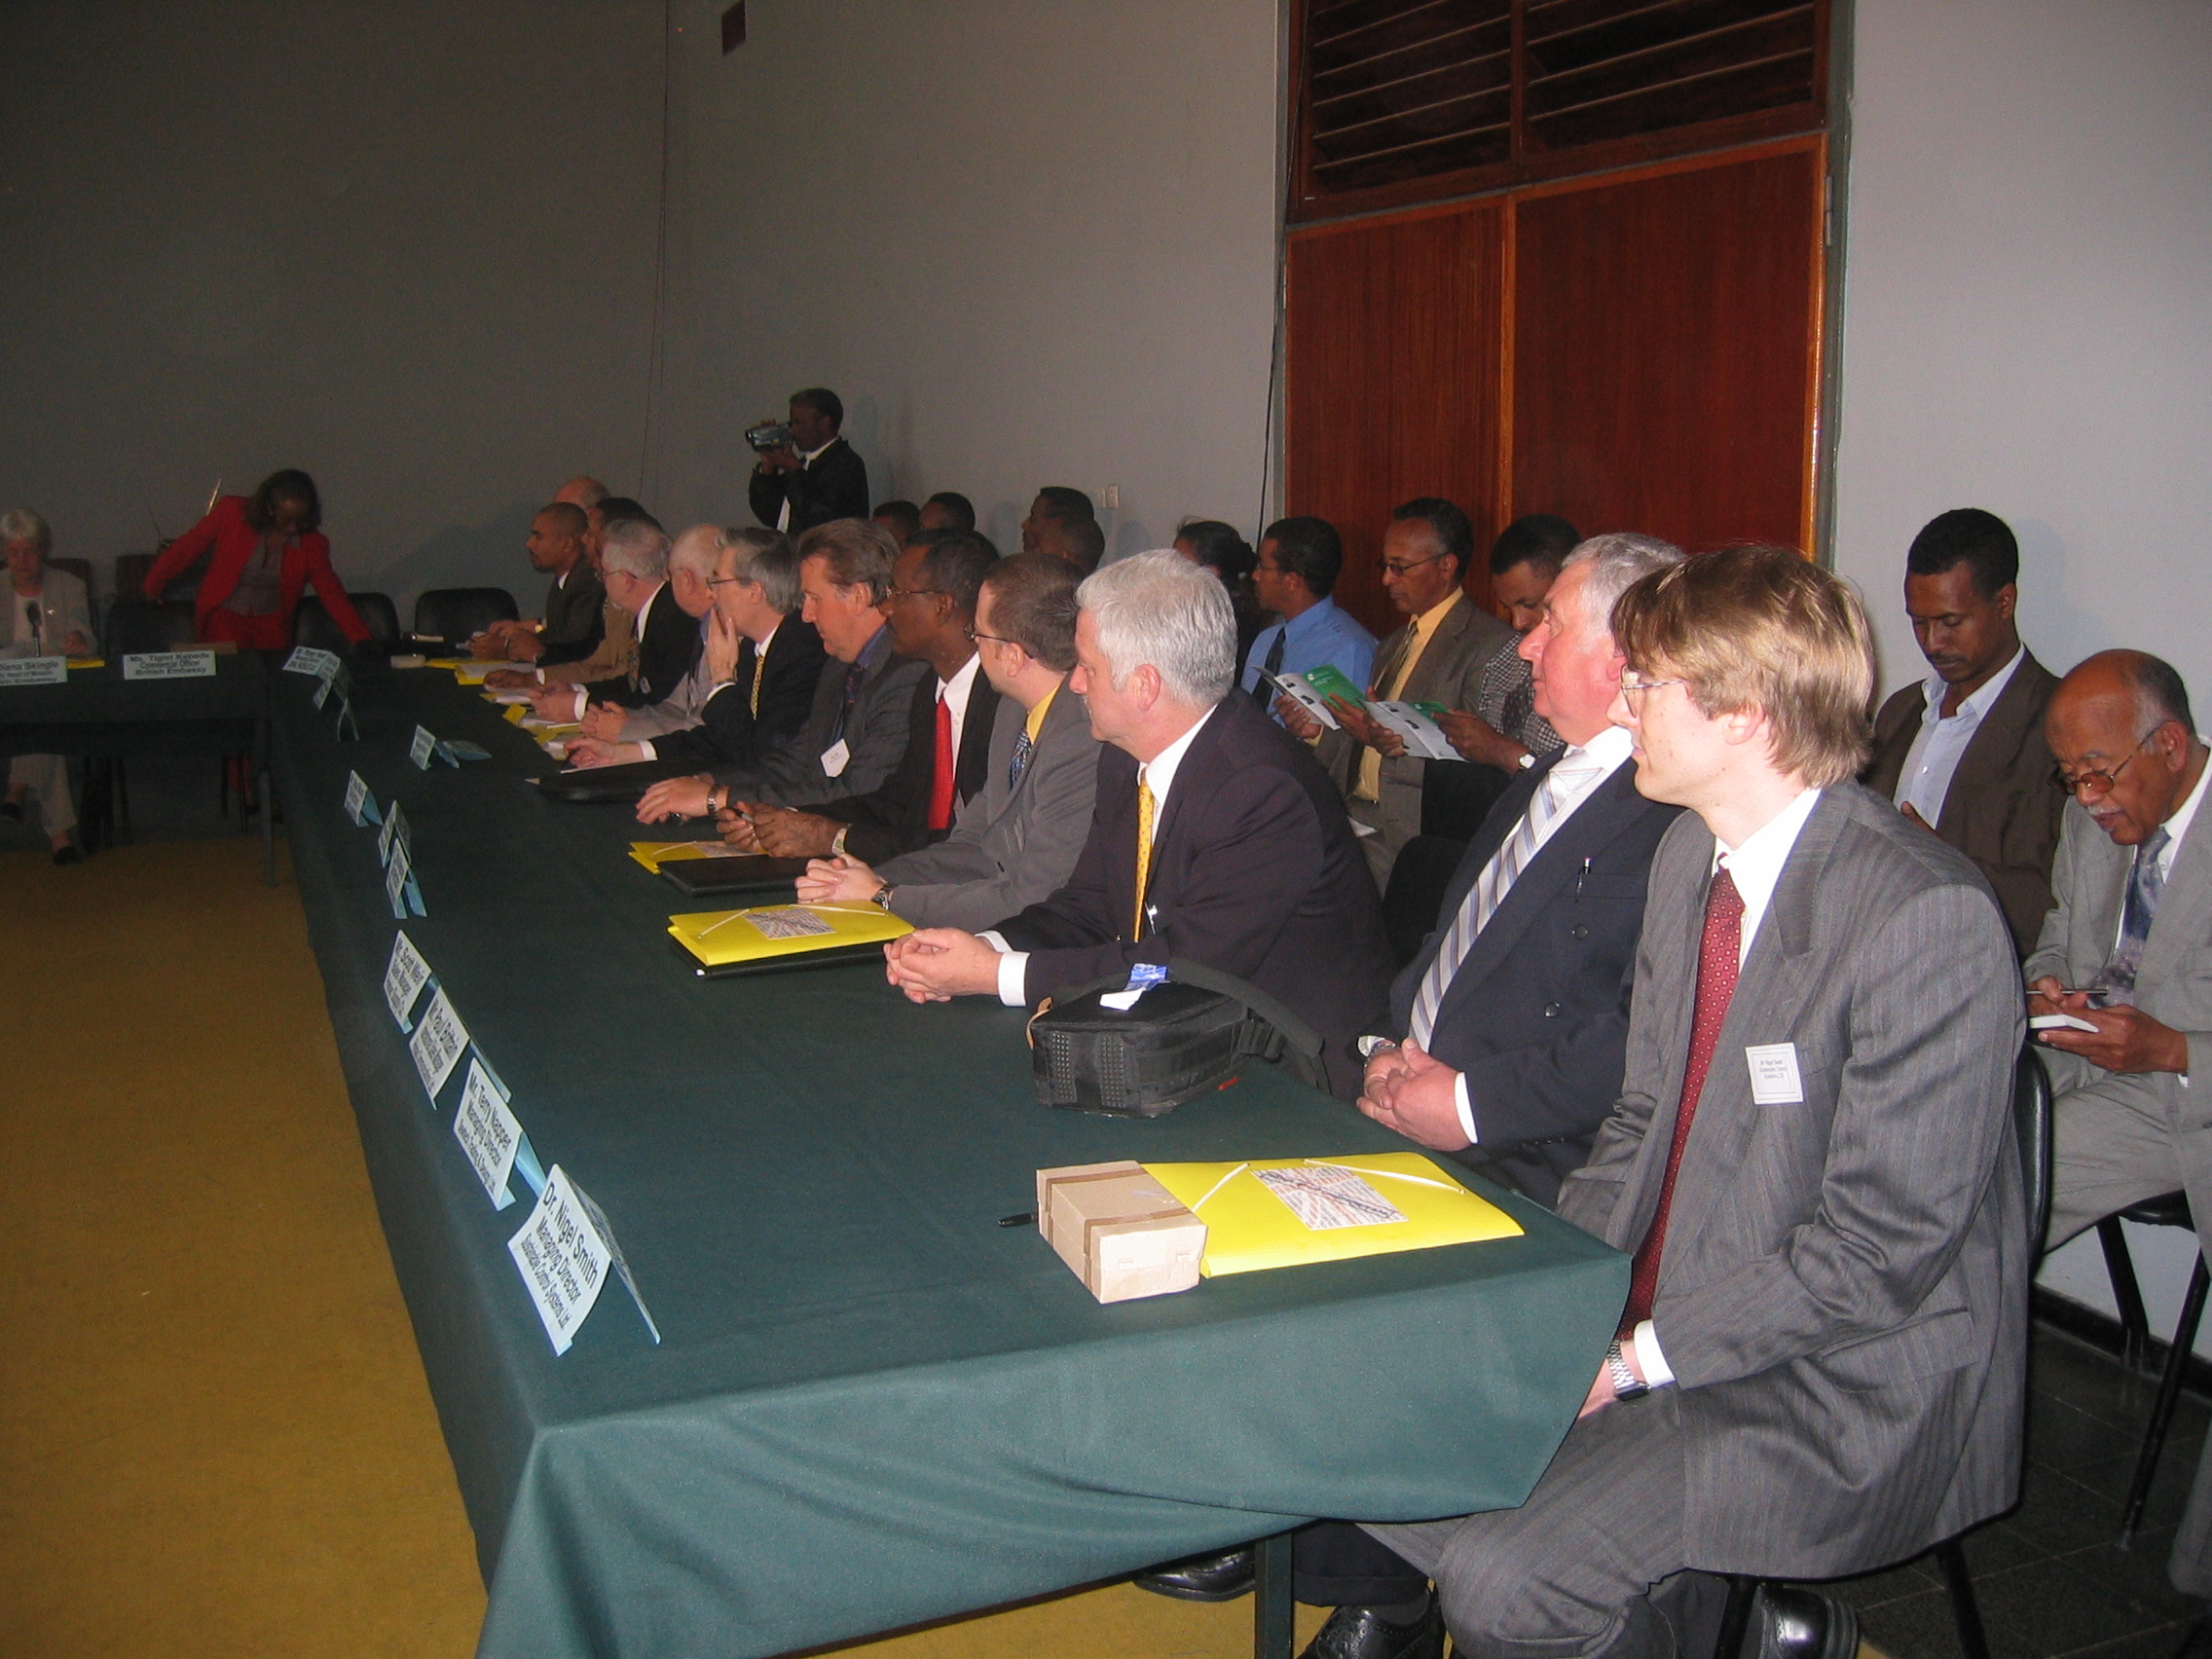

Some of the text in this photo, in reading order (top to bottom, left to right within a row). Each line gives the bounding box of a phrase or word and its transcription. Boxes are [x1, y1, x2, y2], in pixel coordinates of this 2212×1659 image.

[478, 1084, 492, 1123] Terry
[521, 1232, 541, 1271] Sustainable
[542, 1181, 598, 1289] Dr. Nigel Smith
[535, 1262, 553, 1291] Control
[536, 1215, 581, 1305] Managing Director
[543, 1283, 565, 1323] Systems
